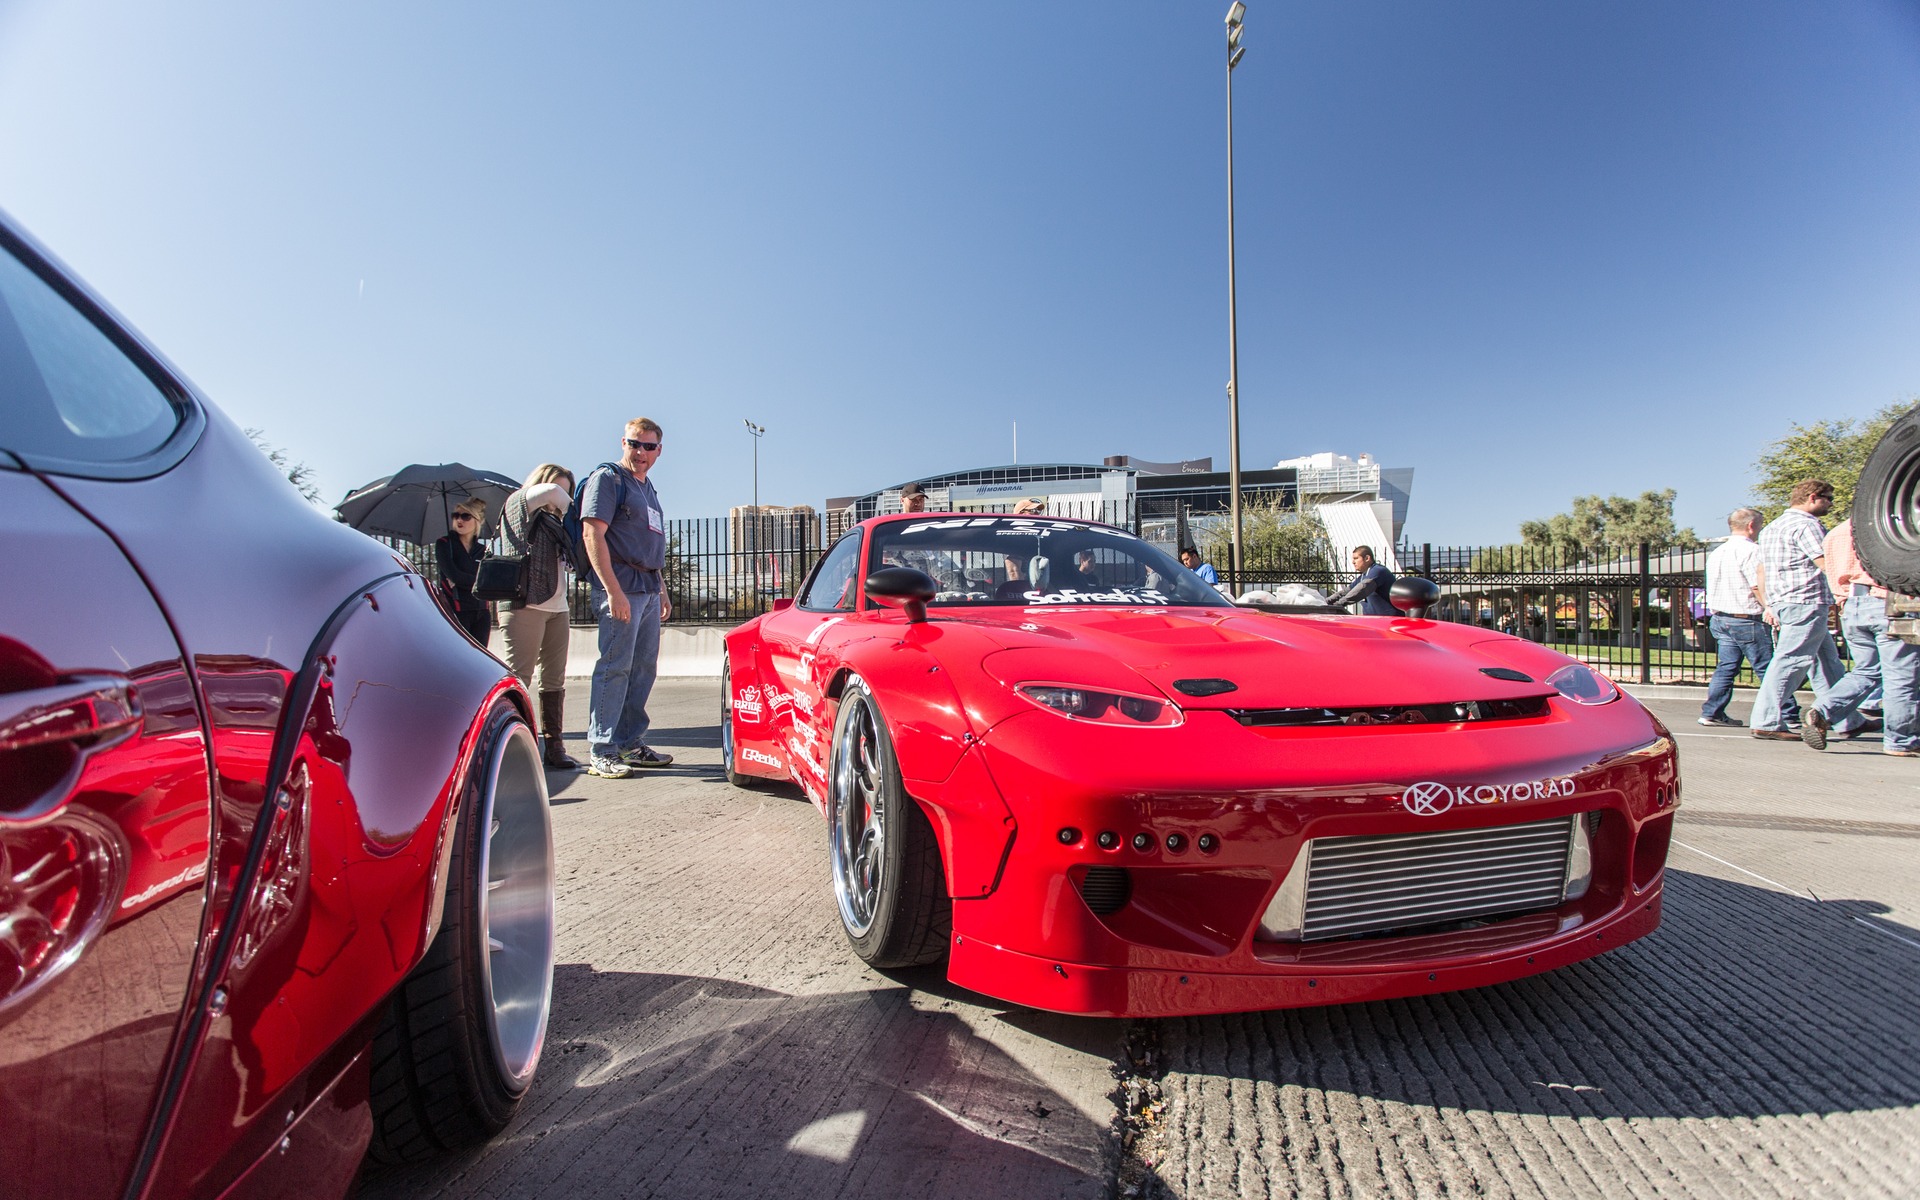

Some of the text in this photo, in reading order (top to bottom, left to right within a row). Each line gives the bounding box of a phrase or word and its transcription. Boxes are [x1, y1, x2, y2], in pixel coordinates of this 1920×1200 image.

[1182, 463, 1206, 473] Encore
[734, 700, 762, 712] BRIDE
[742, 748, 782, 769] GReddy
[1456, 778, 1576, 805] KOYORAD
